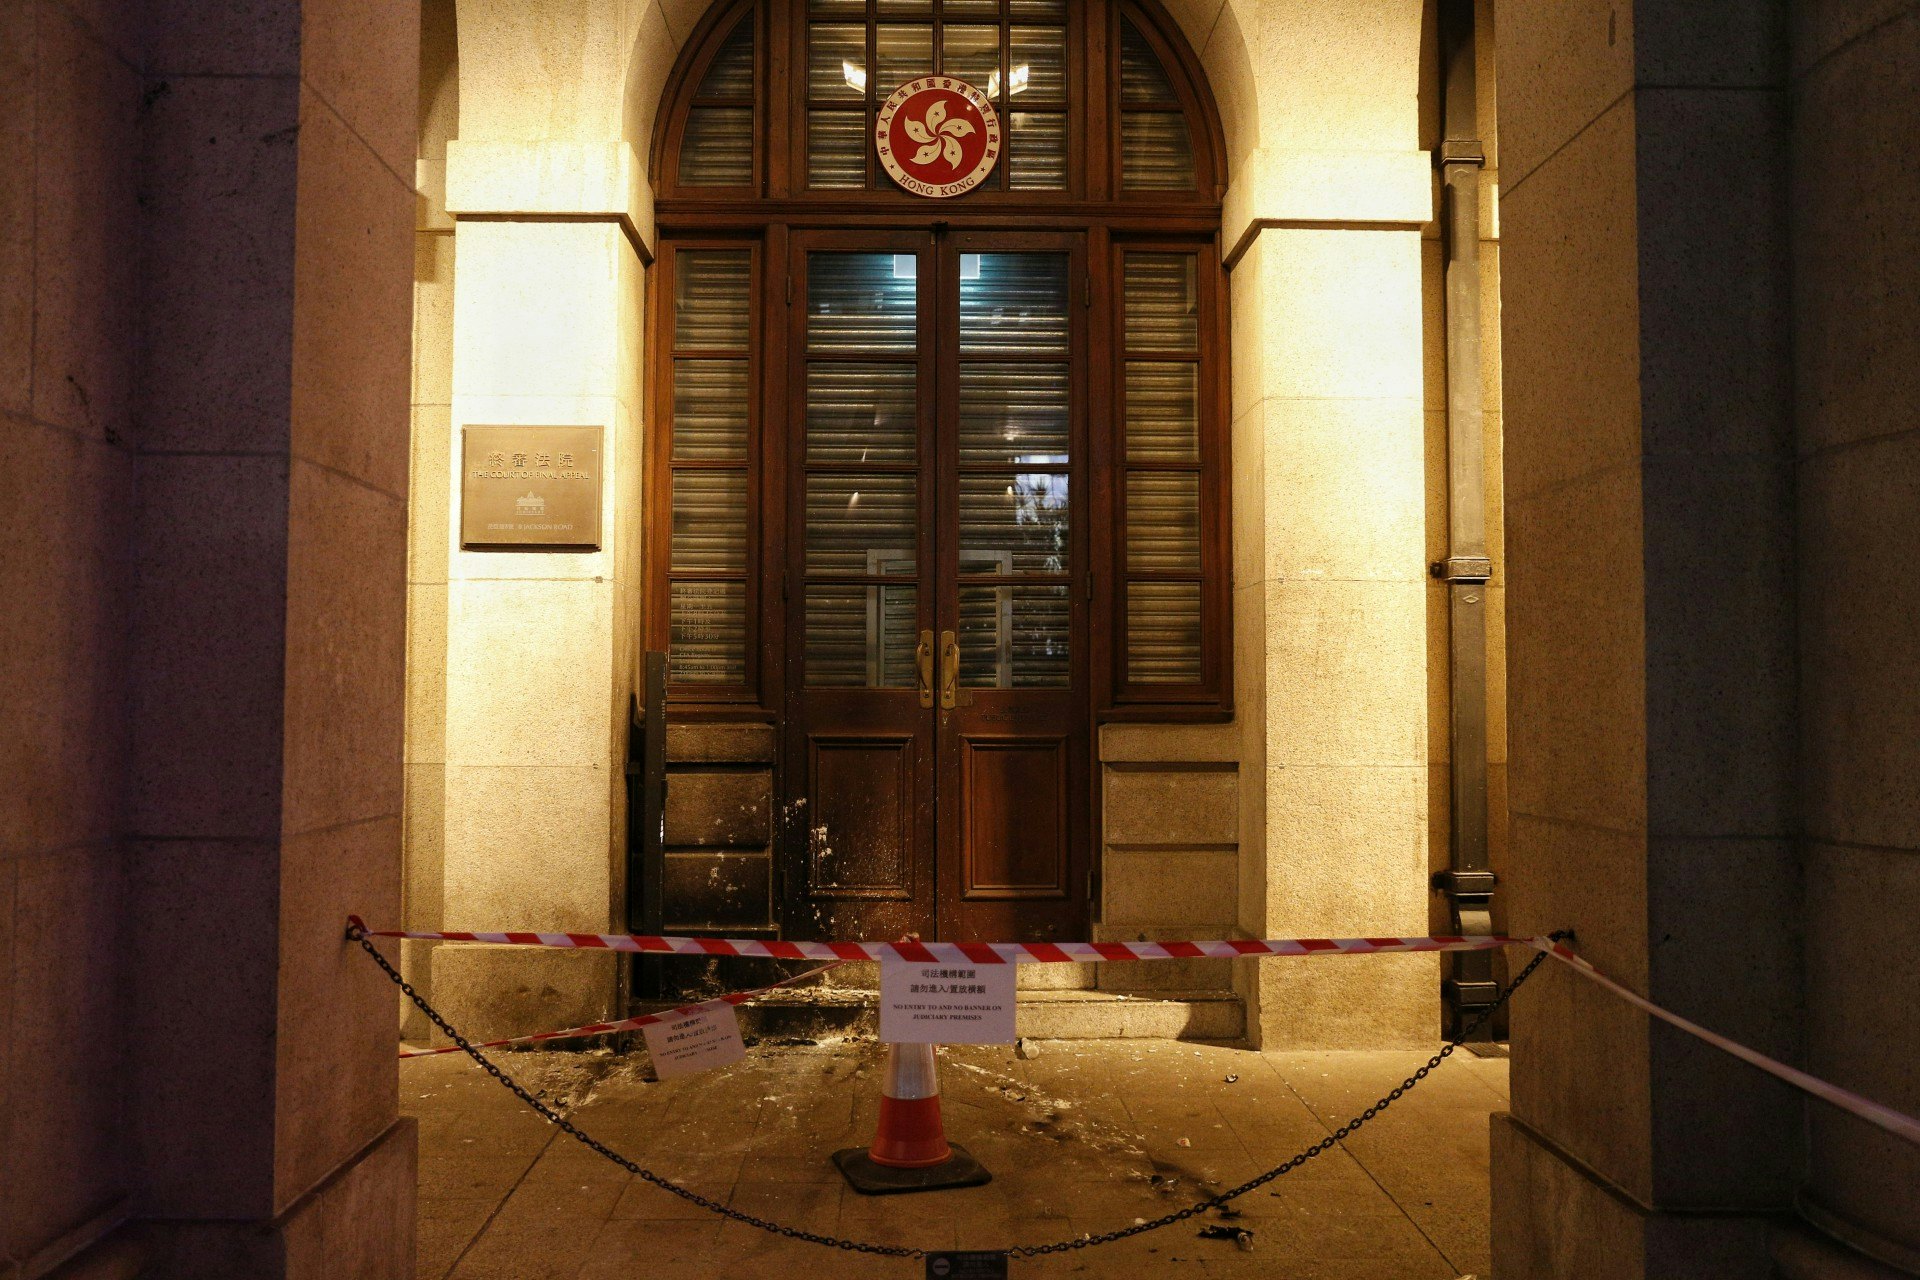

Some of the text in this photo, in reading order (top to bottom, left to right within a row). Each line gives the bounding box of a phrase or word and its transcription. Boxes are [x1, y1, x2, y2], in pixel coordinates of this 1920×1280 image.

[899, 174, 975, 196] HONG KONG
[488, 452, 574, 468] 終審法院
[472, 471, 590, 480] THE COURT OF FINAL APPEAL
[523, 523, 552, 531] JACKSON
[553, 523, 574, 531] ROAD
[921, 969, 976, 979] 司法機構範圍
[910, 984, 986, 994] 請勿進入/置放橫額
